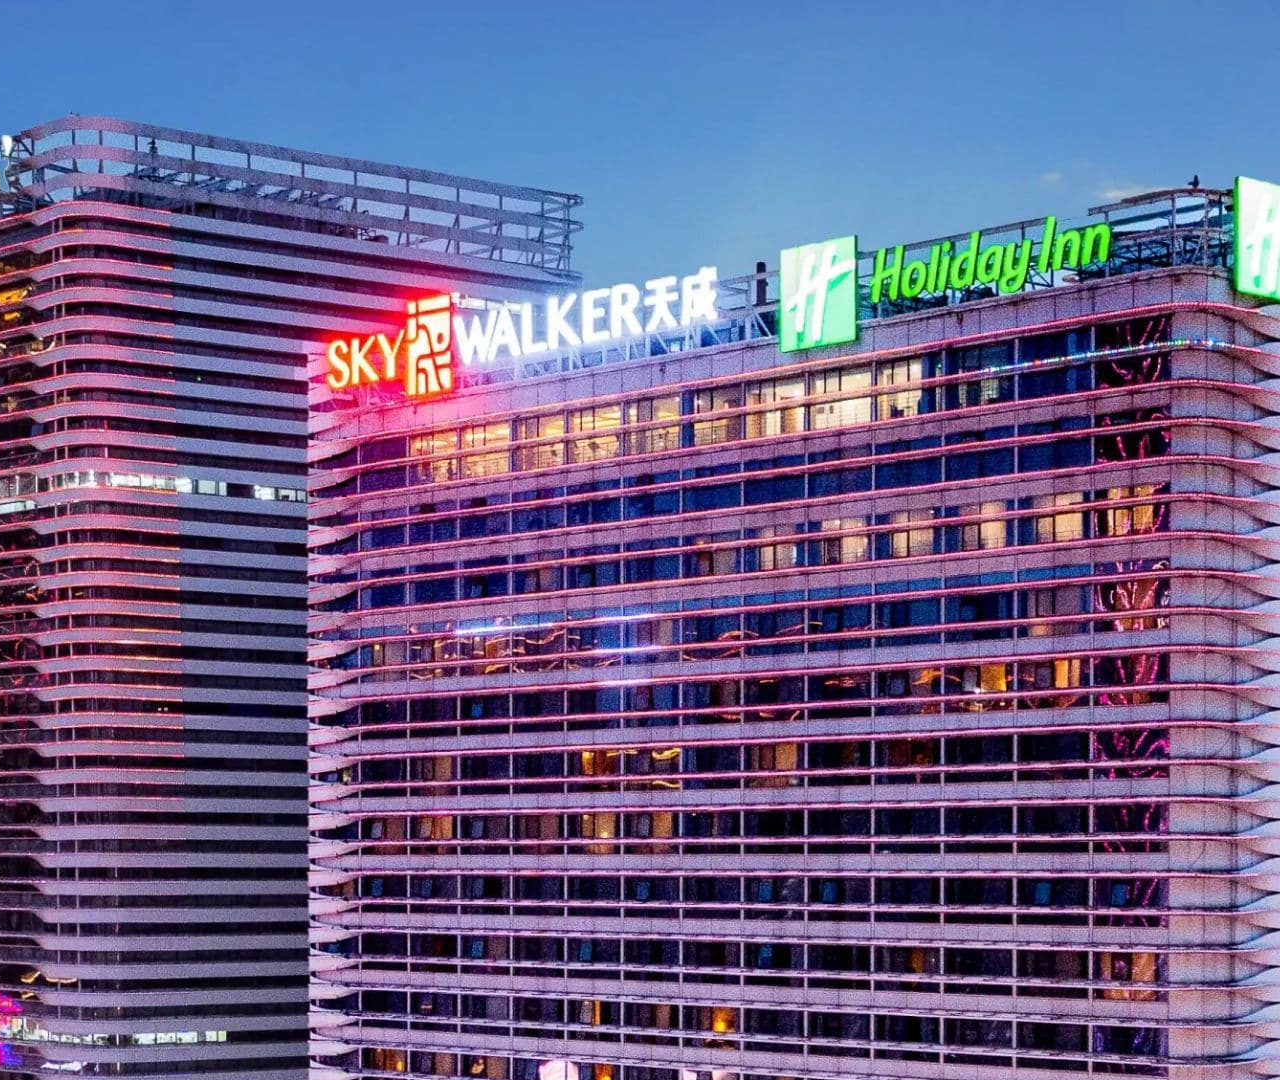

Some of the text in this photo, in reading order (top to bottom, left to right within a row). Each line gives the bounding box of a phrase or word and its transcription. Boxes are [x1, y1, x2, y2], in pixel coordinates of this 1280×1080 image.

[869, 215, 1112, 303] Holiday Inn
[326, 328, 407, 390] SKY
